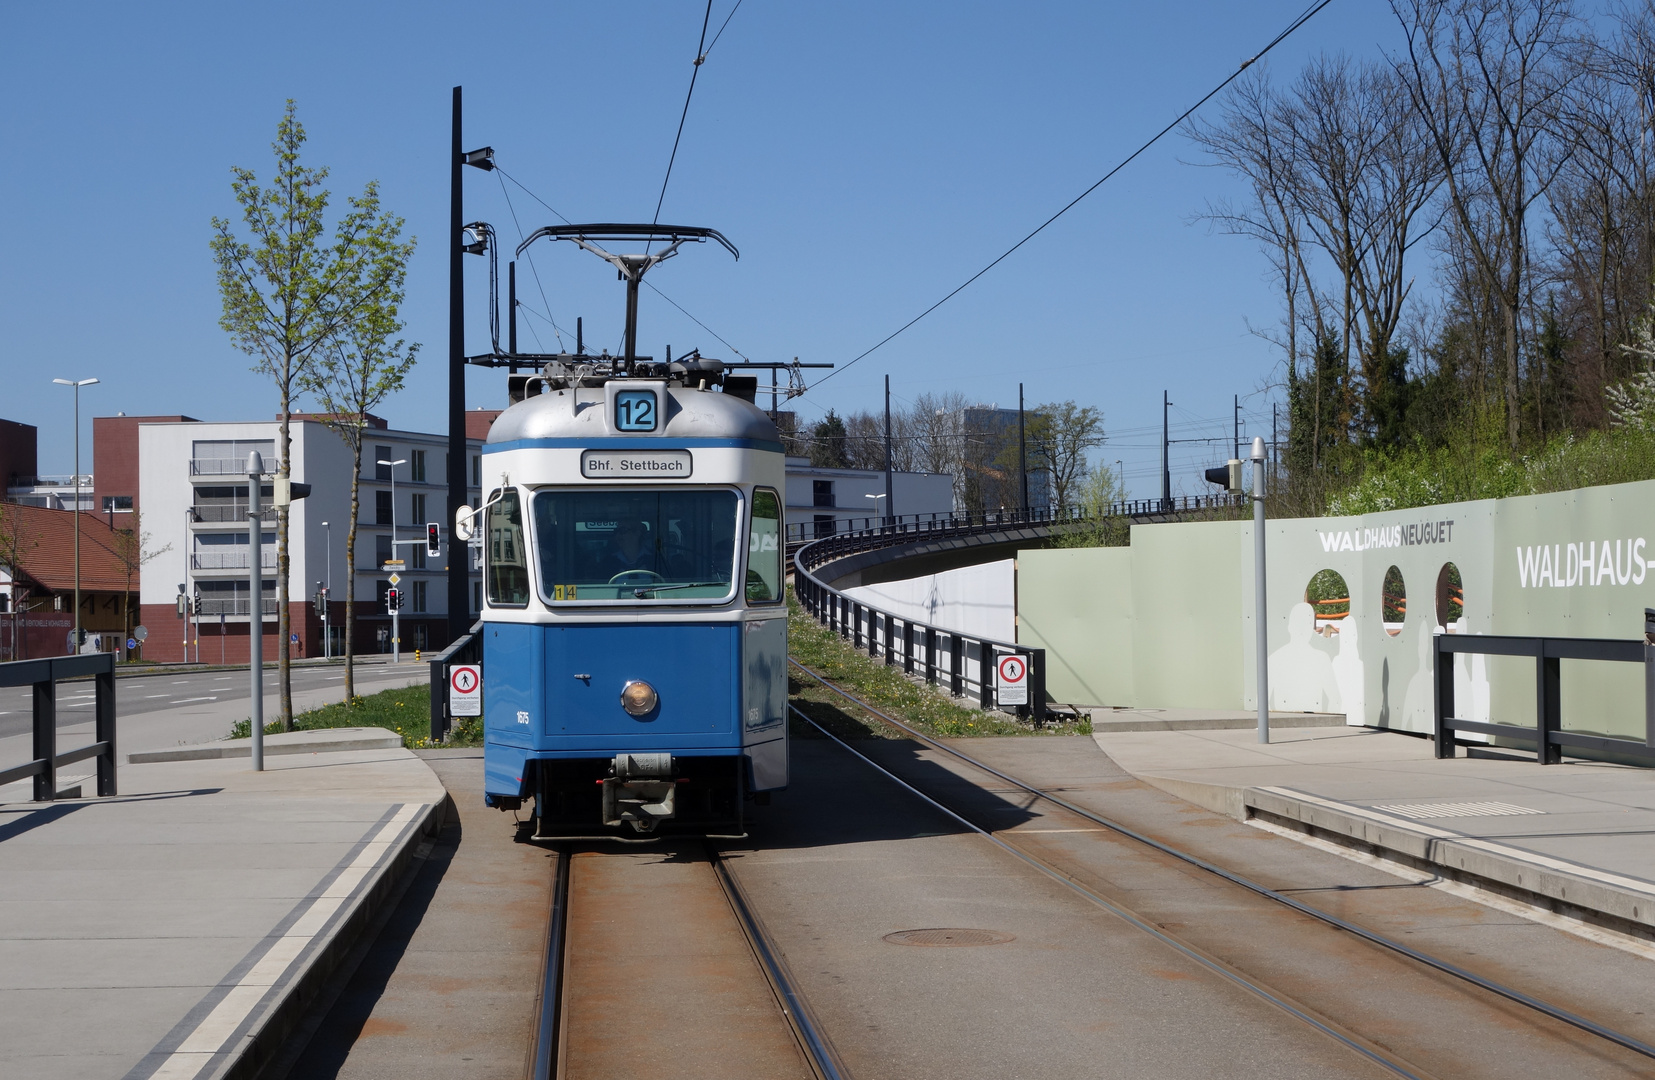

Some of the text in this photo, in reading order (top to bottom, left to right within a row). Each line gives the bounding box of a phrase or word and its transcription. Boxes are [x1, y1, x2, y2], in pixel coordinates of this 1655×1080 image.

[620, 399, 652, 425] 12
[589, 459, 683, 471] Bhf. Stettbach
[1319, 520, 1454, 552] WALDHAUSNEUGUET
[516, 710, 529, 724] 1675
